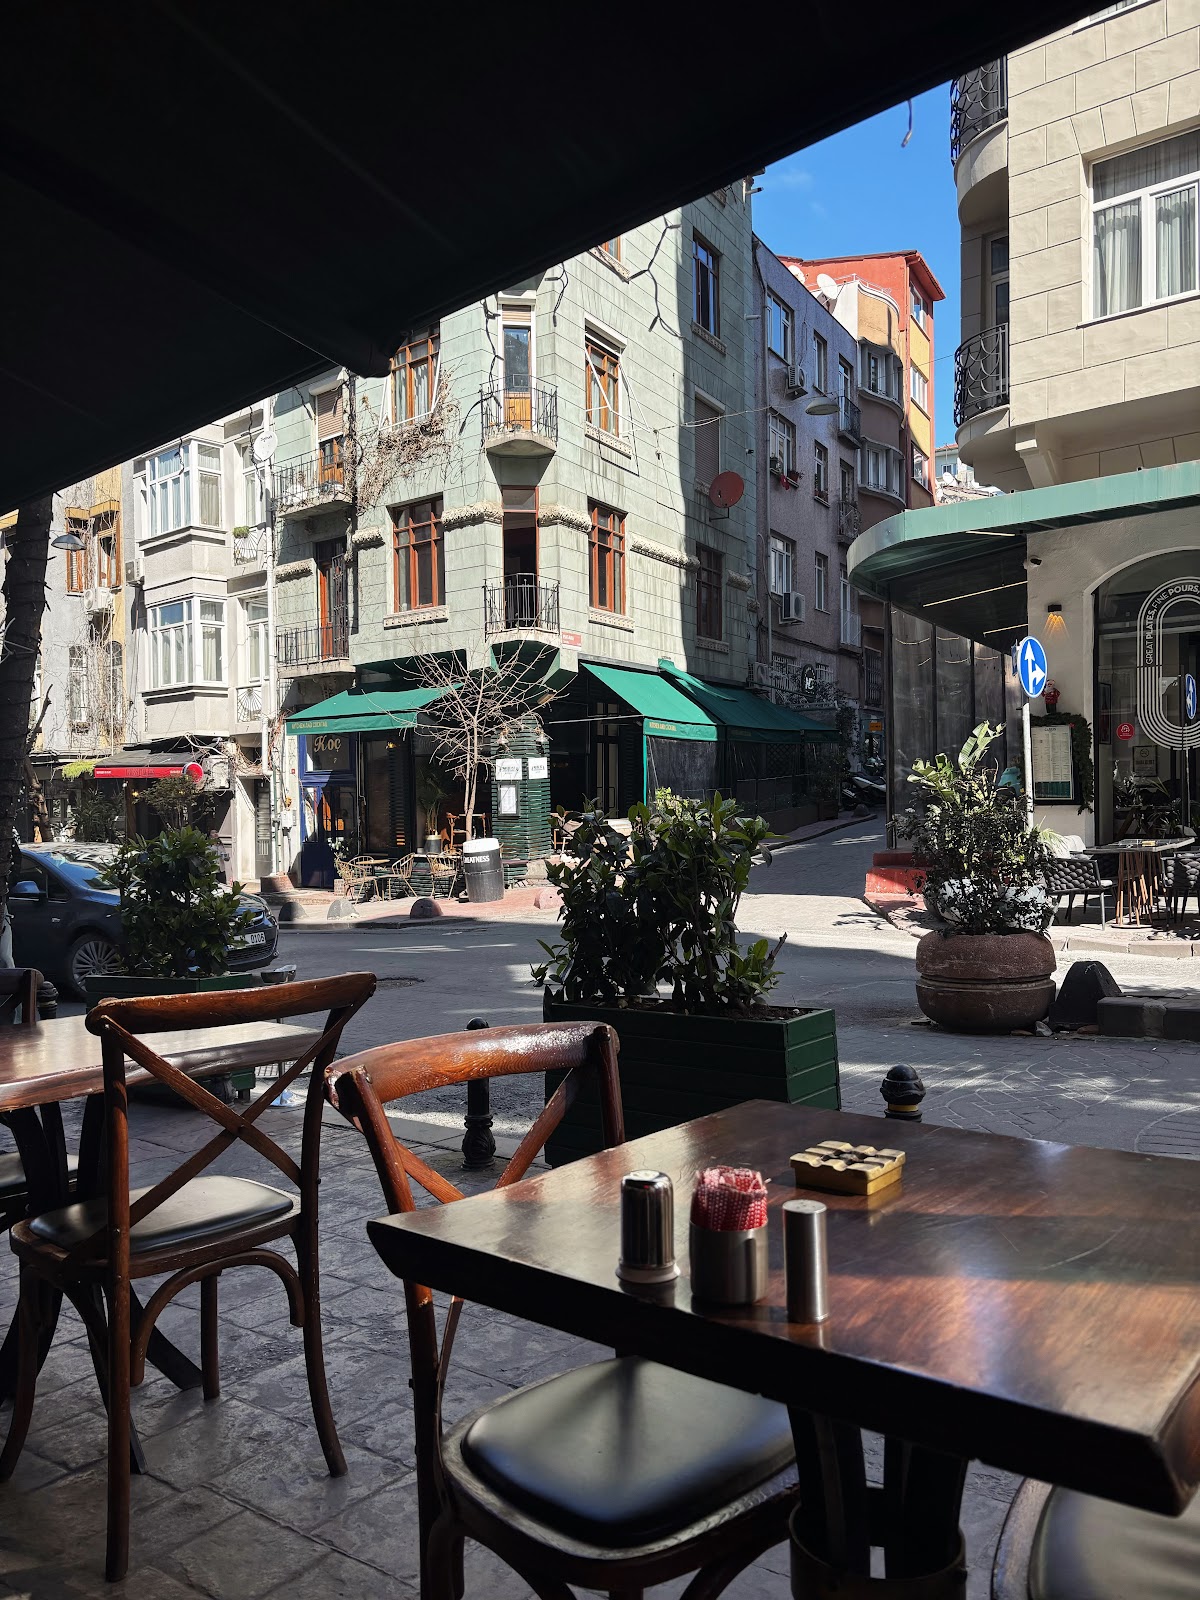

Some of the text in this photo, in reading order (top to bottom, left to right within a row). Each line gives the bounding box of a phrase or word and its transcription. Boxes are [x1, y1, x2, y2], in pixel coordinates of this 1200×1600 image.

[1146, 584, 1200, 665] GREAT PLATES, FINE POURS,
